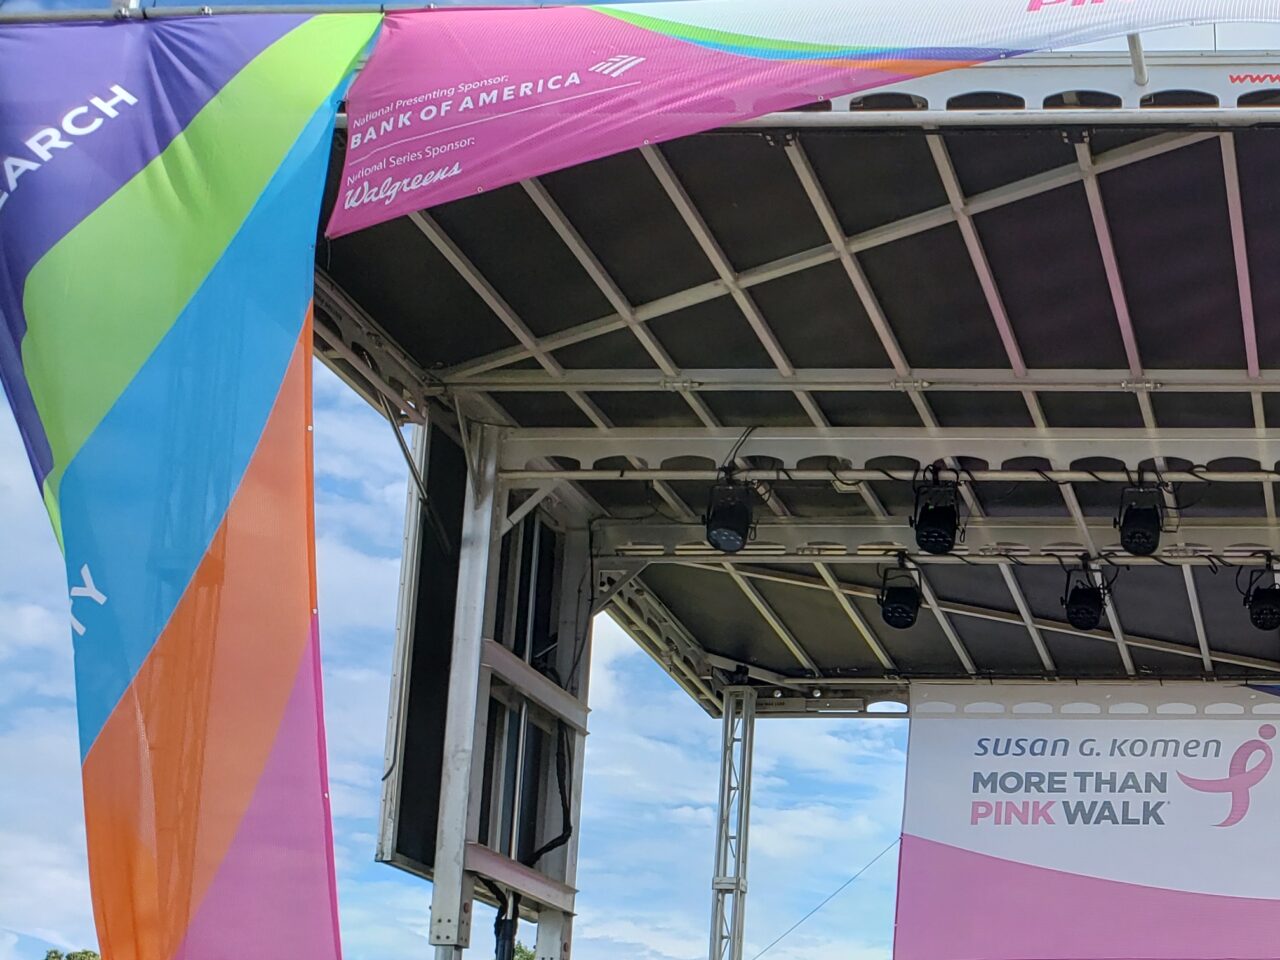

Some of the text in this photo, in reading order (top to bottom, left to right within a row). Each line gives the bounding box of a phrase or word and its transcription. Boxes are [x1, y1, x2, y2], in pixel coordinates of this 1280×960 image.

[351, 72, 580, 149] BANK OF AMERICA
[353, 75, 509, 128] National Presenting Sponsor:
[0, 84, 138, 210] ARCH
[389, 151, 422, 167] Series
[425, 136, 475, 158] Sponsor:
[344, 162, 462, 209] Walgreens
[1079, 738, 1101, 757] G.
[972, 771, 1167, 794] MORE THAN
[970, 800, 1056, 826] PINK
